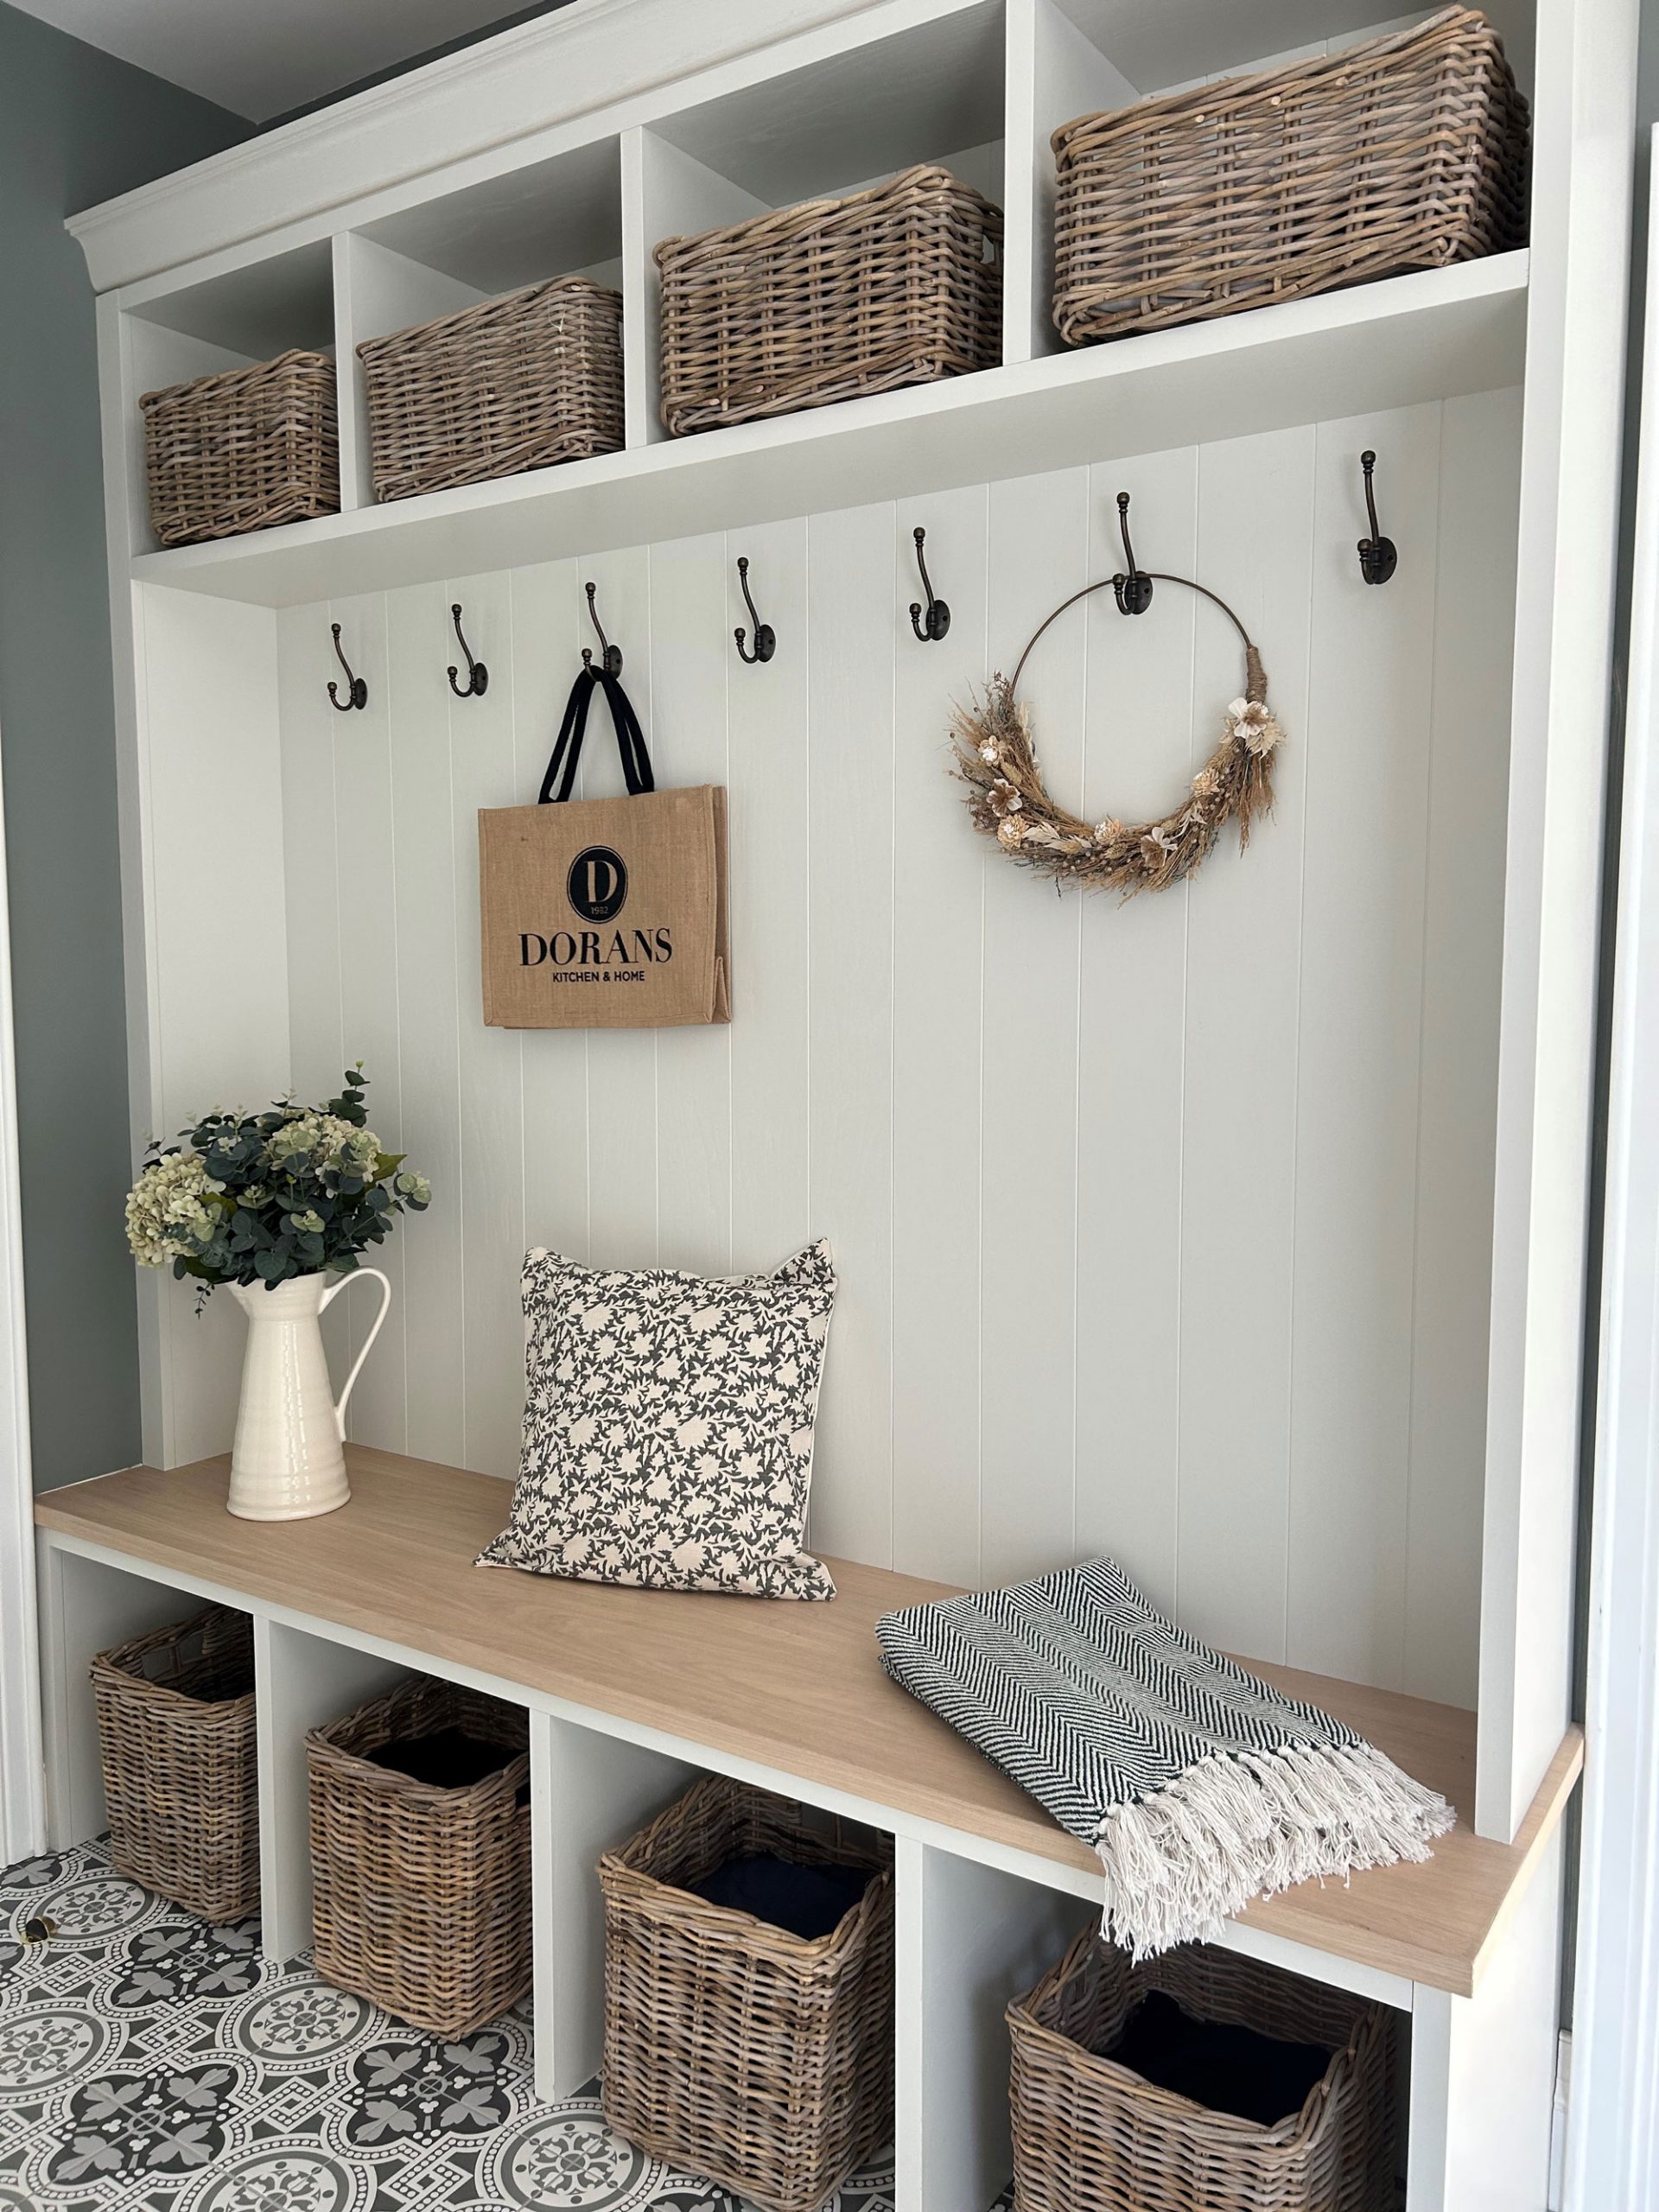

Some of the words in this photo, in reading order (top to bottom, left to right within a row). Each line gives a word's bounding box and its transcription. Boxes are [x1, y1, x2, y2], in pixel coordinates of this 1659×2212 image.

[584, 860, 618, 903] D
[518, 928, 672, 966] DORANS
[552, 971, 600, 982] KITCHEN
[602, 971, 611, 982] &
[613, 970, 645, 982] HOME
